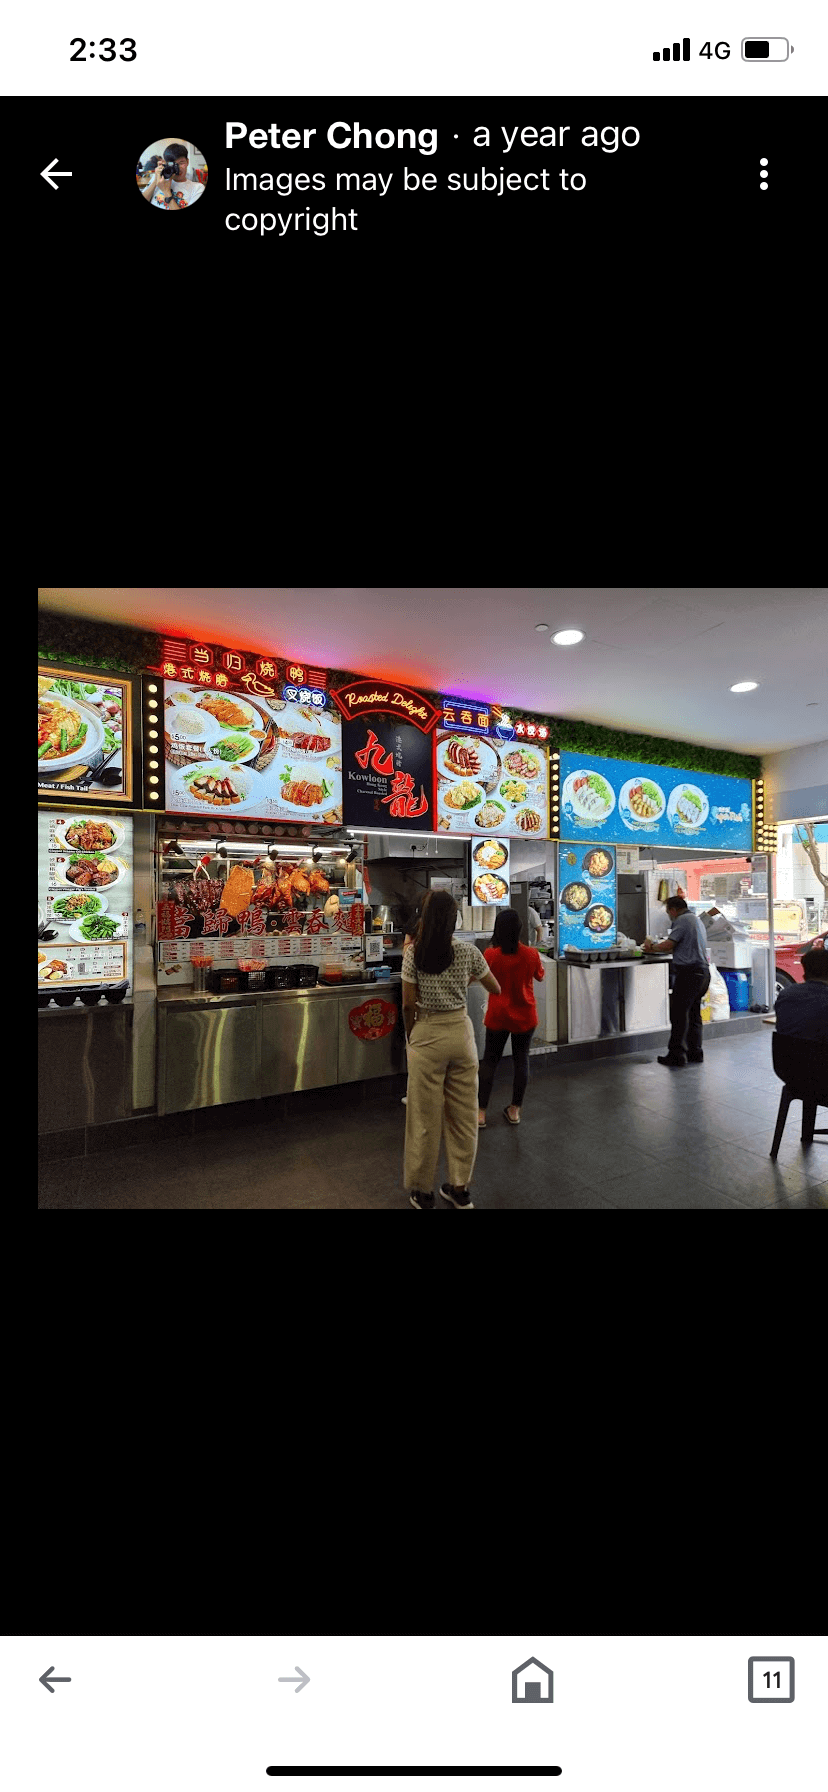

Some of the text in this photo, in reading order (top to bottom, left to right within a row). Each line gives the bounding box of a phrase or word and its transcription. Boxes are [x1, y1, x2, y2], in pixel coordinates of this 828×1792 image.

[194, 647, 304, 684] 当归烧鸭
[345, 690, 428, 720] Roasted Delight
[443, 707, 489, 728] 云吞面
[38, 781, 56, 789] Meat
[60, 782, 75, 790] Fish
[347, 770, 388, 784] Kowloon
